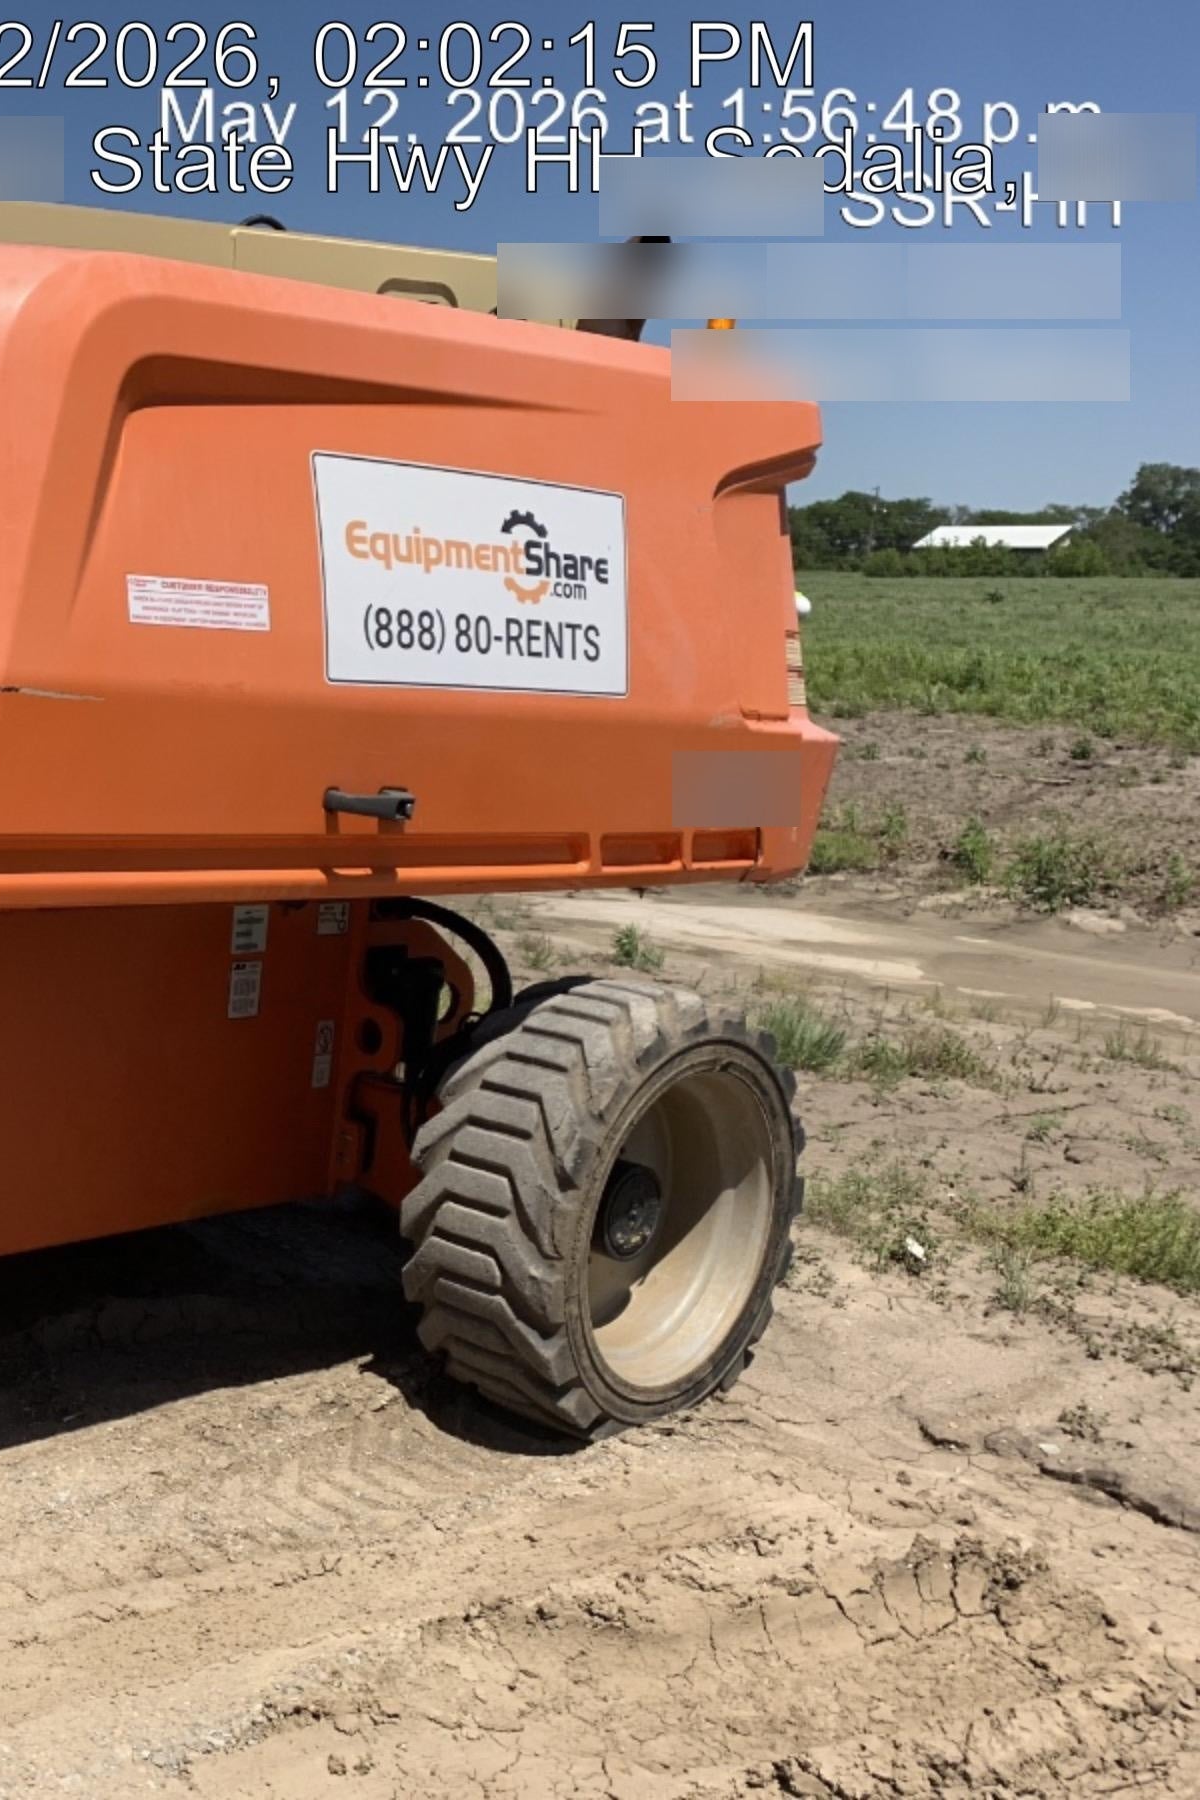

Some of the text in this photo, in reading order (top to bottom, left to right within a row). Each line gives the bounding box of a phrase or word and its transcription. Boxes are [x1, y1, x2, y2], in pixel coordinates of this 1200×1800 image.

[344, 519, 609, 585] EquipmentShare
[549, 580, 588, 601] .com
[362, 602, 602, 663] (888) 80-RENTS
